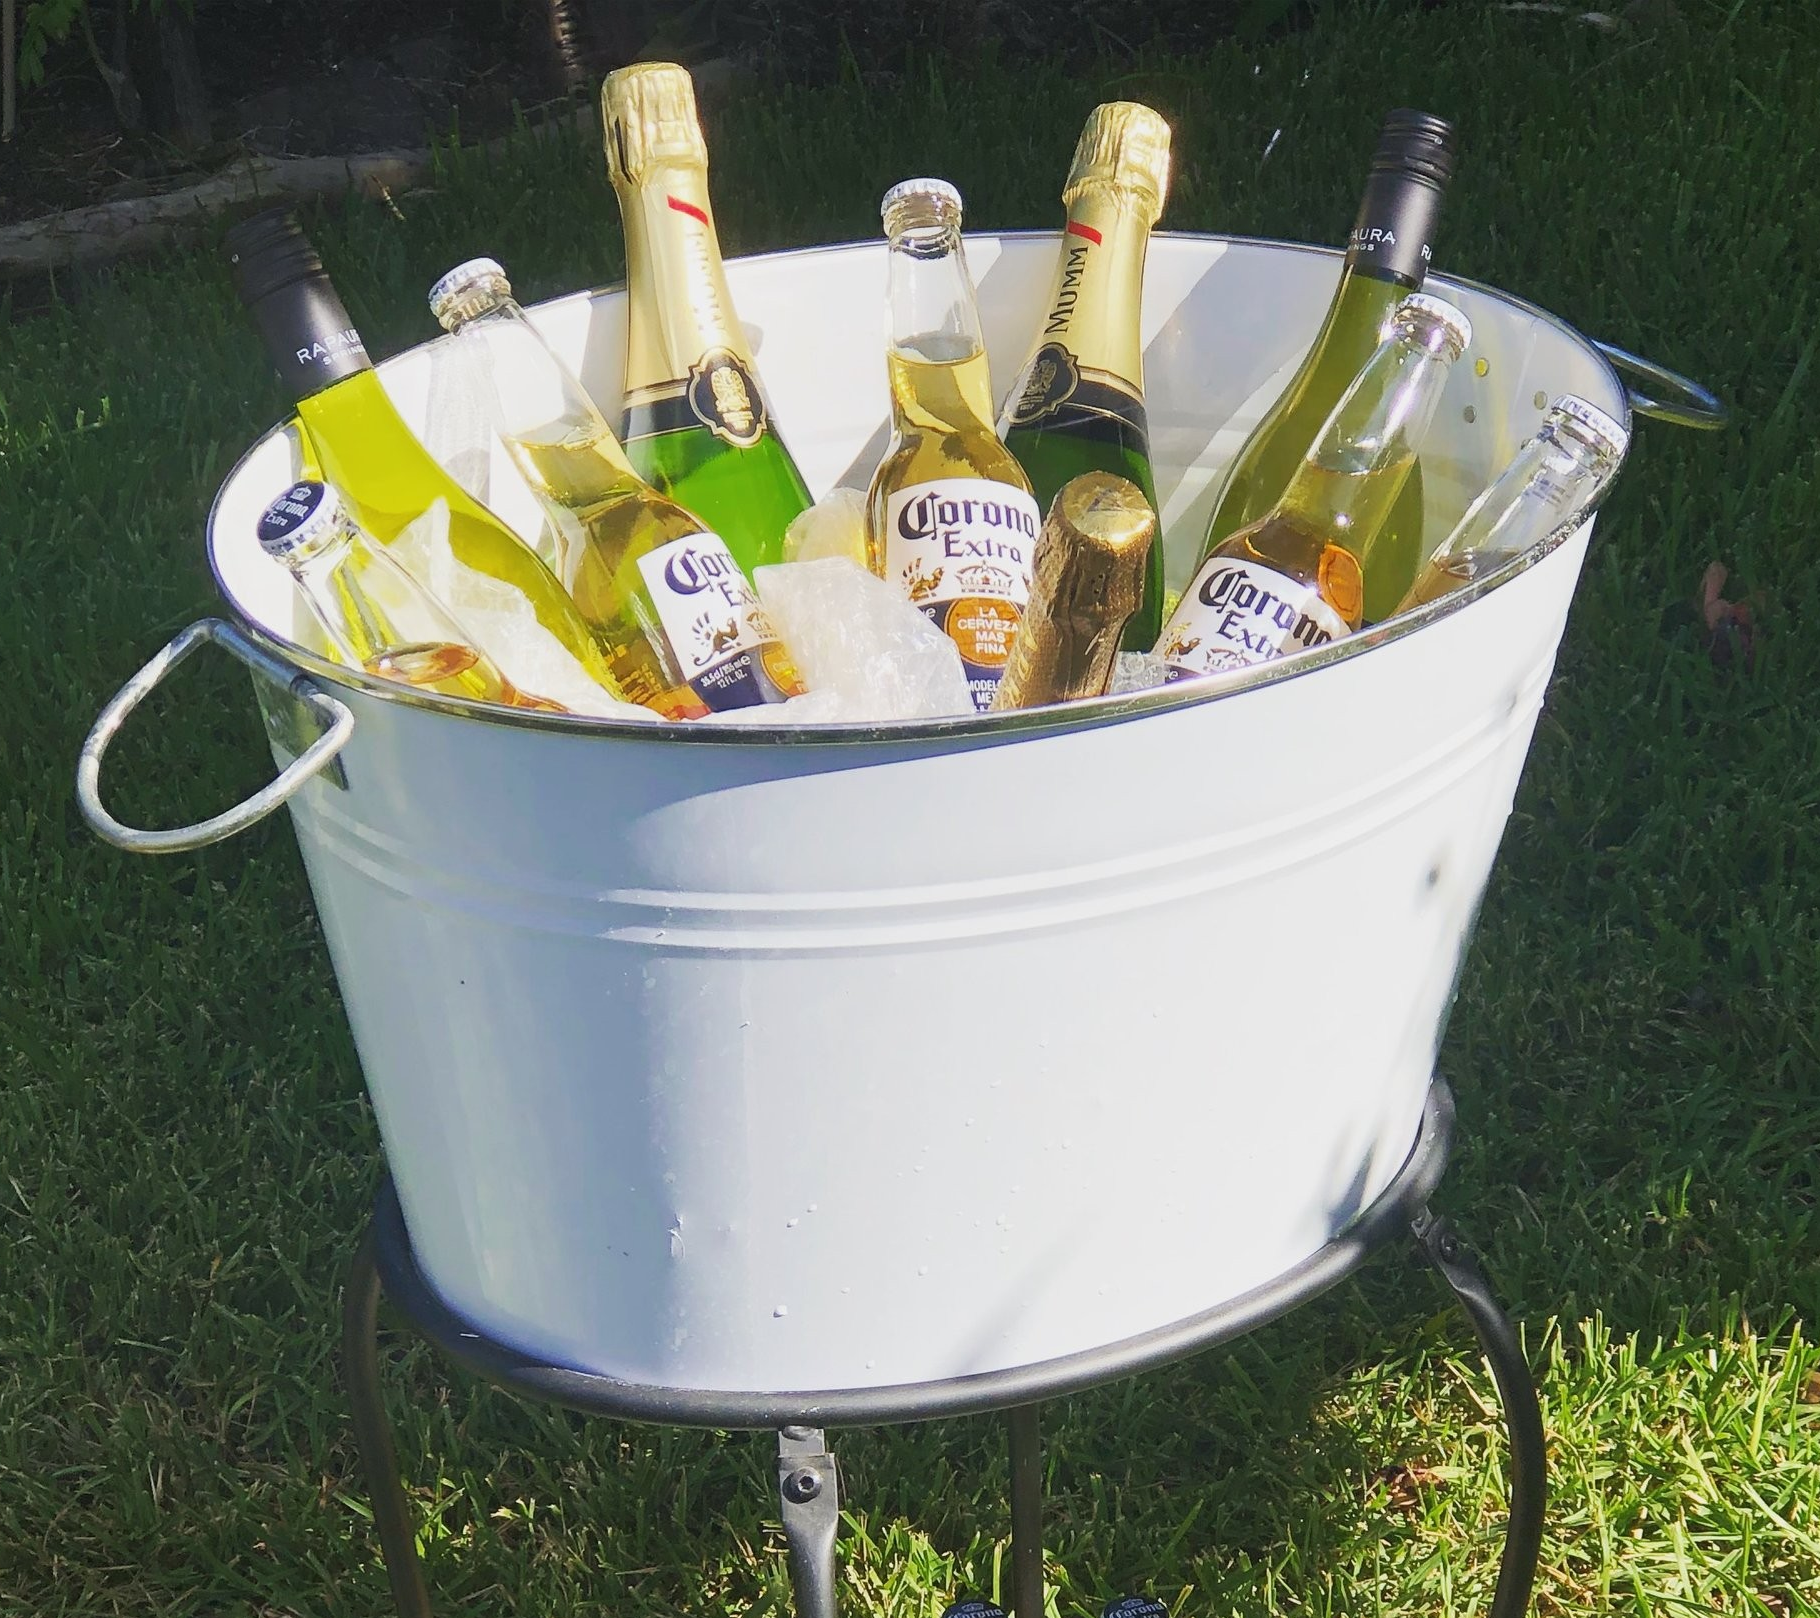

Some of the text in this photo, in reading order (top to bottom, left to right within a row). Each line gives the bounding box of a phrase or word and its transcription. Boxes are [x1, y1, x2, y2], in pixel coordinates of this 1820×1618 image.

[1043, 246, 1088, 336] MUMM
[272, 496, 309, 520] Corona
[265, 511, 288, 526] Extra
[898, 491, 1037, 541] Corona
[942, 530, 1022, 564] Extra
[979, 606, 999, 618] LA
[957, 618, 1019, 632] CERVEZA
[976, 631, 1006, 643] MAS
[975, 642, 1008, 656] FINA
